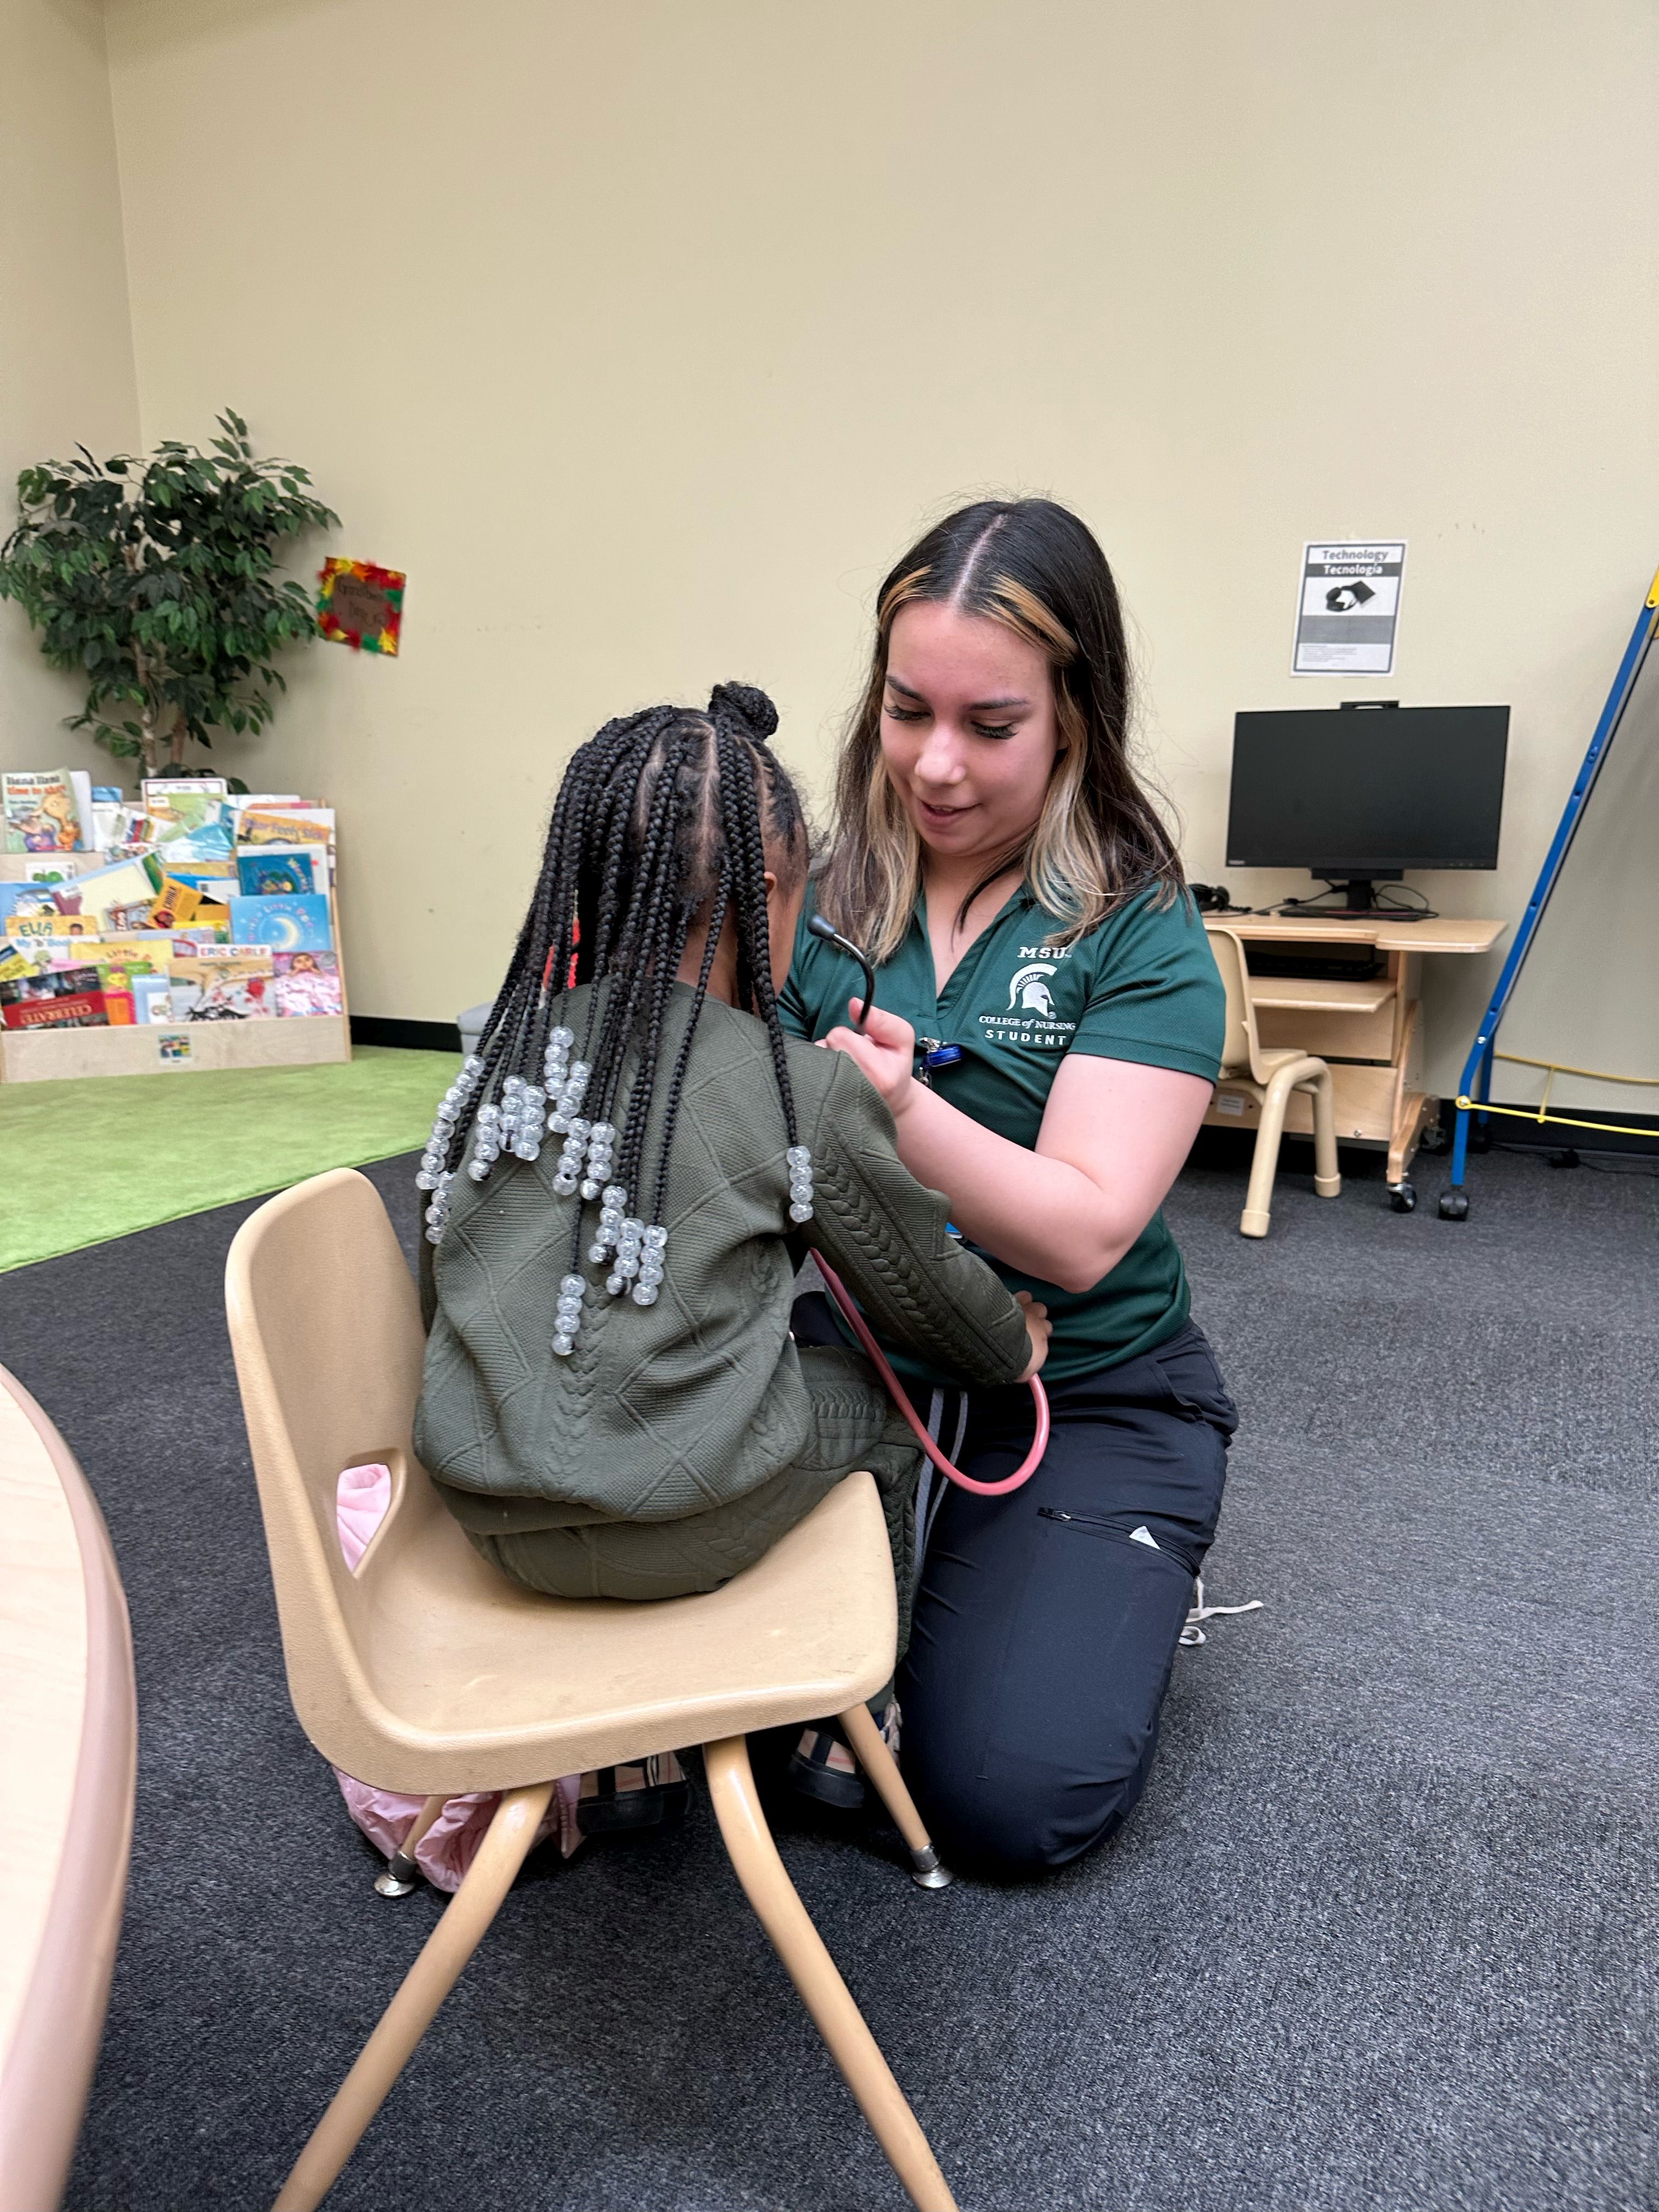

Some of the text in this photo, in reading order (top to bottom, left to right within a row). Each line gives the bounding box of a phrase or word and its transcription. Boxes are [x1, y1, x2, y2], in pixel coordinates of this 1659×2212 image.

[1323, 549, 1390, 562] Technology
[1324, 563, 1383, 577] Tecnología
[200, 947, 227, 957] ERIC
[1017, 946, 1068, 959] MSU
[979, 1015, 1076, 1030] COLLEGE of NURSING
[985, 1029, 1066, 1045] STUDENT
